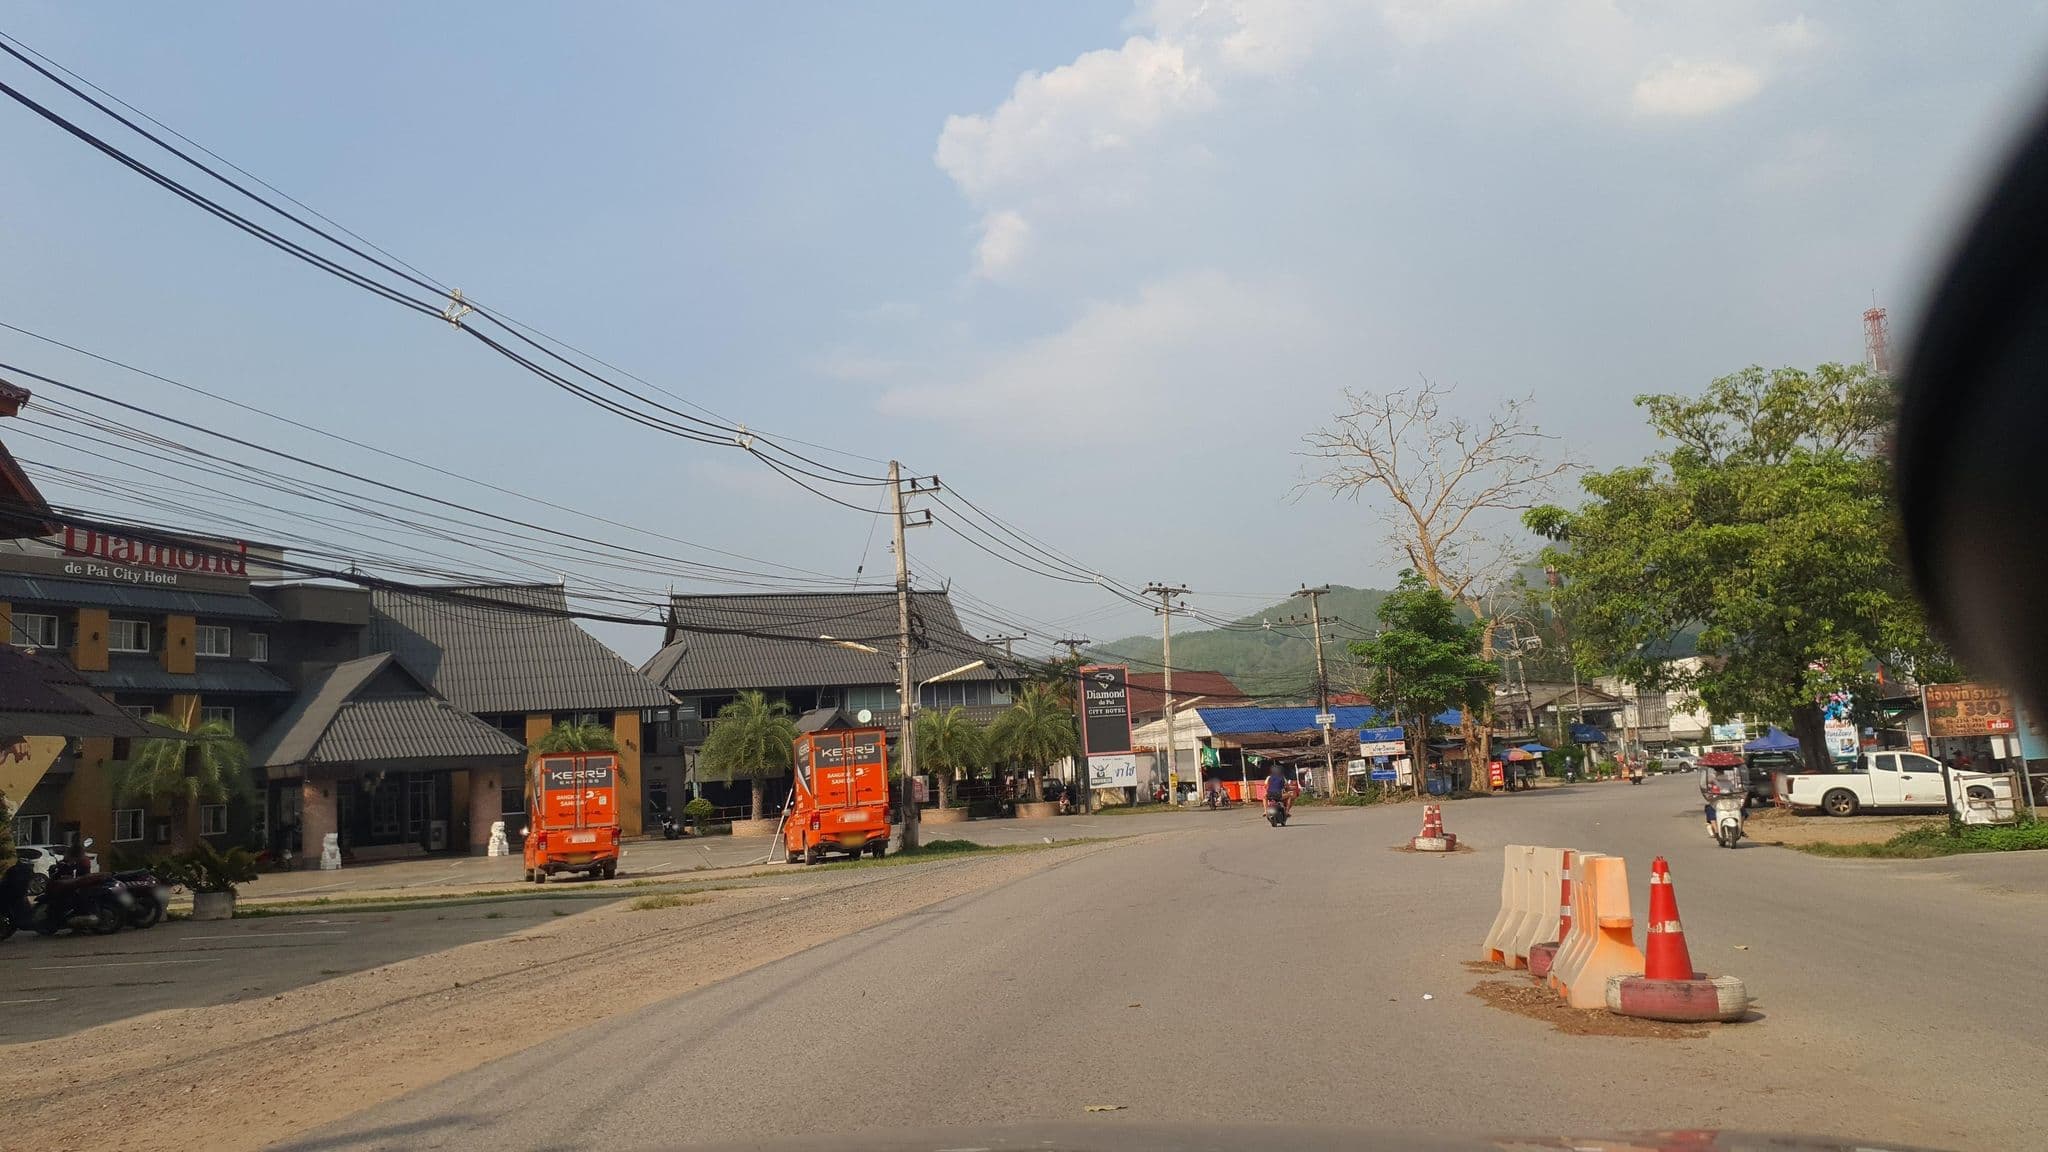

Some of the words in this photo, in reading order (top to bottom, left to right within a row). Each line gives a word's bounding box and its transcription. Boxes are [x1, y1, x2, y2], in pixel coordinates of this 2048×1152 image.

[63, 526, 249, 577] Diamond
[64, 561, 82, 575] de
[86, 563, 109, 579] Pai
[113, 567, 142, 584] City
[144, 571, 178, 585] Hotel
[1086, 688, 1126, 700] Diamond
[821, 743, 875, 757] KERRY
[551, 767, 607, 780] KERRY
